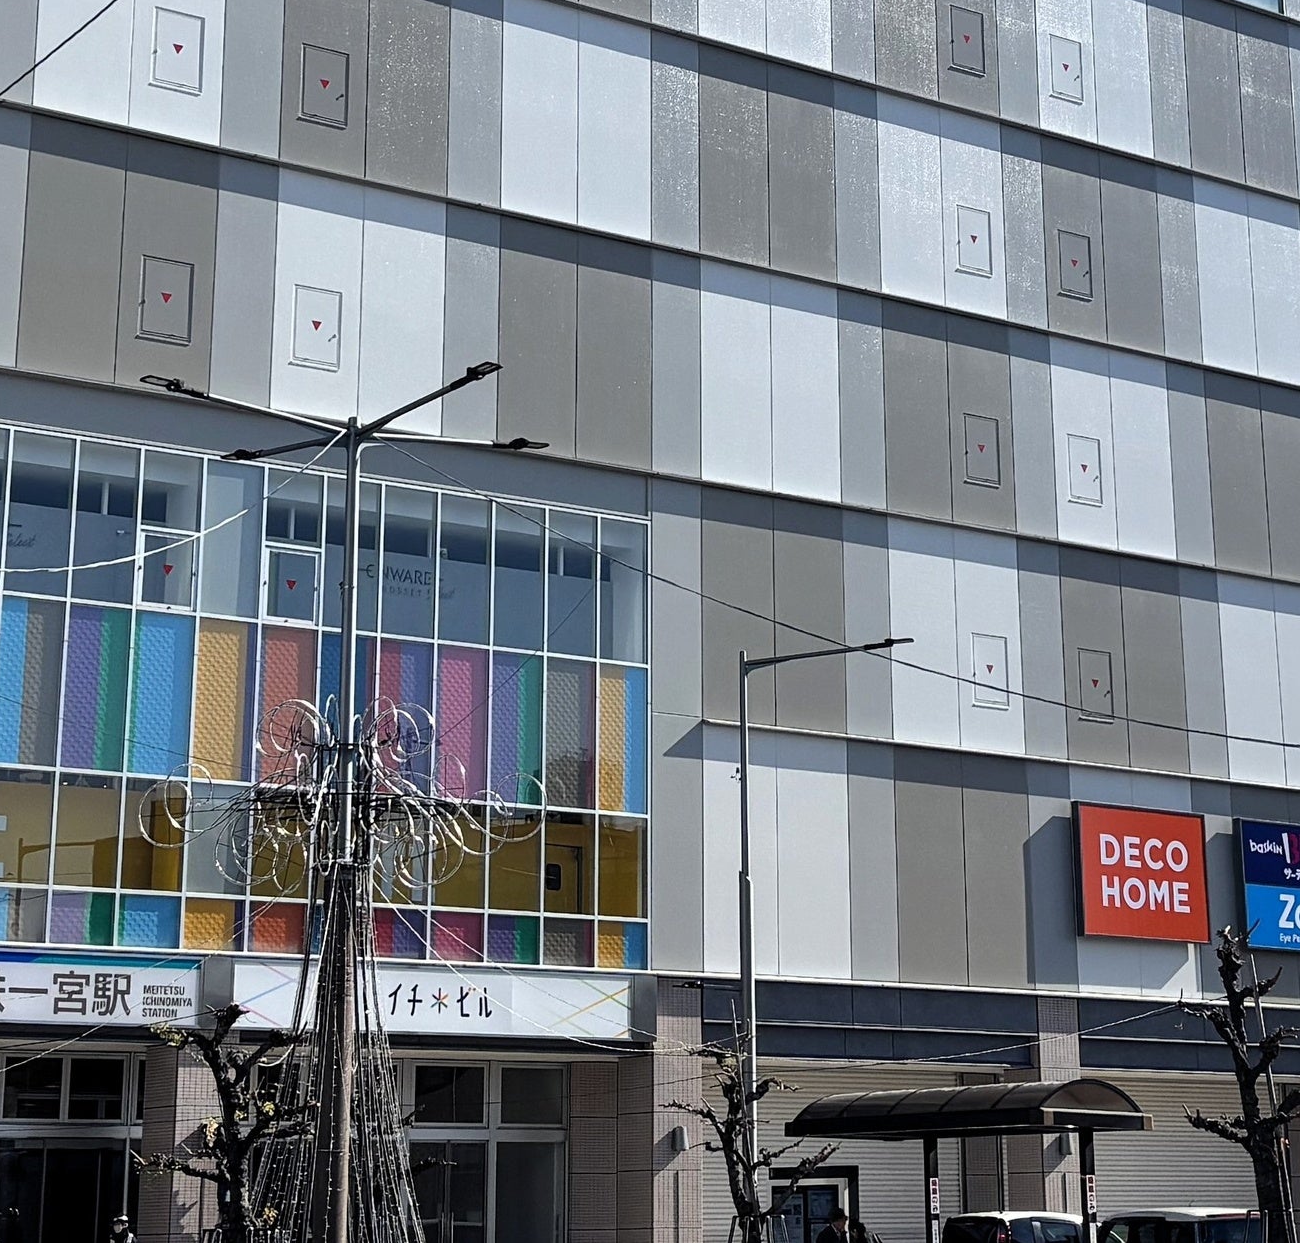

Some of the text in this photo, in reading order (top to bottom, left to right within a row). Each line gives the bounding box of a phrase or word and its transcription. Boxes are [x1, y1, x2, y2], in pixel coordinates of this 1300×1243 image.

[1249, 839, 1283, 855] baskin
[1099, 833, 1189, 873] DECO
[1101, 875, 1191, 914] HOME
[1280, 933, 1291, 944] Eye
[143, 985, 185, 995] MEITETSU
[142, 996, 193, 1007] ICHINOMIYA
[142, 1007, 178, 1018] STATION
